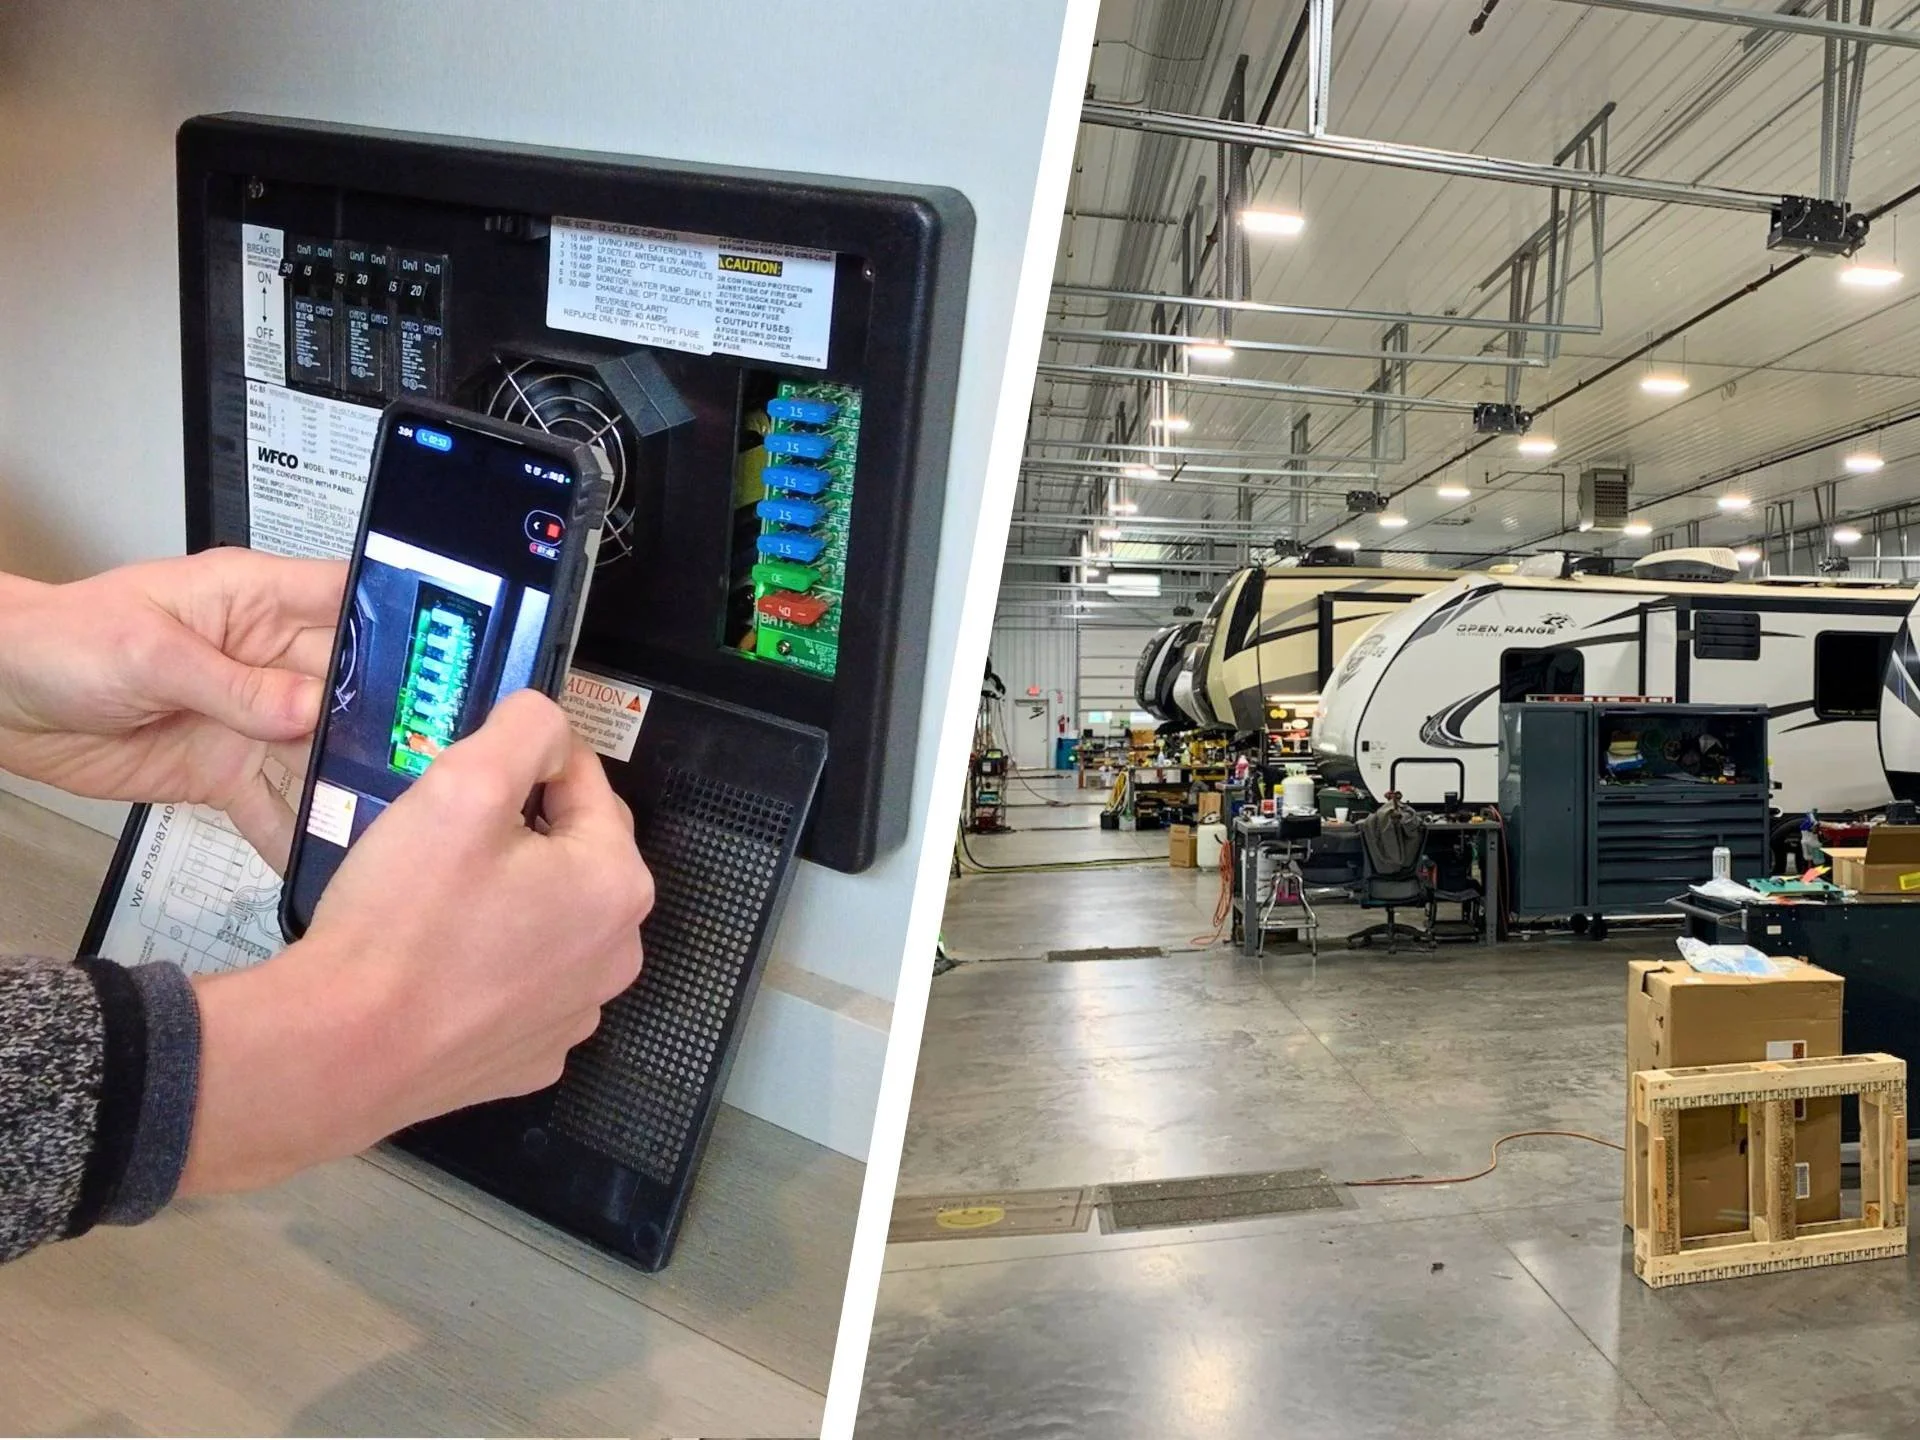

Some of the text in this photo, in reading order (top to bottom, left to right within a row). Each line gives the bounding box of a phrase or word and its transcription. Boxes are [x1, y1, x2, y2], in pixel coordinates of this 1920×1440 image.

[258, 232, 270, 243] AC
[246, 242, 281, 258] BREAKERS
[283, 264, 293, 274] 30
[304, 266, 312, 276] 15
[596, 264, 632, 277] FURNACE
[258, 270, 272, 284] ON
[336, 273, 344, 284] 15
[356, 274, 368, 286] 20
[389, 281, 398, 292] 15
[410, 286, 422, 296] 20
[716, 283, 740, 292] GAINST
[726, 276, 766, 288] CONTINUED
[767, 282, 812, 294] PROTECTION
[595, 295, 668, 314] REVERSE POLARITY
[715, 298, 785, 314] NLY WITH SAME TYPE
[770, 298, 802, 308] REPLACE
[594, 304, 614, 314] FUSE
[634, 310, 644, 319] 40
[646, 312, 668, 323] AMPS
[724, 307, 750, 317] RATING
[761, 312, 780, 321] FUSE
[563, 308, 700, 338] REPLACE ONLY WITH ATC TYPE FUSE
[714, 316, 721, 324] C
[722, 317, 758, 329] OUTPUT
[256, 326, 274, 340] OFF
[713, 334, 738, 344] EPLACE
[778, 334, 792, 343] NOT
[782, 384, 796, 396] F1
[790, 406, 802, 418] 15
[786, 442, 800, 454] 15
[258, 446, 298, 470] WFCO
[252, 463, 274, 474] POWER
[275, 469, 314, 484] CONVERTER
[332, 483, 354, 494] PANEL
[783, 476, 796, 488] 15
[780, 510, 792, 520] 15
[780, 544, 792, 554] 15
[778, 605, 791, 616] 40
[1456, 624, 1556, 635] OPEN RANGE
[567, 676, 626, 706] AUTION
